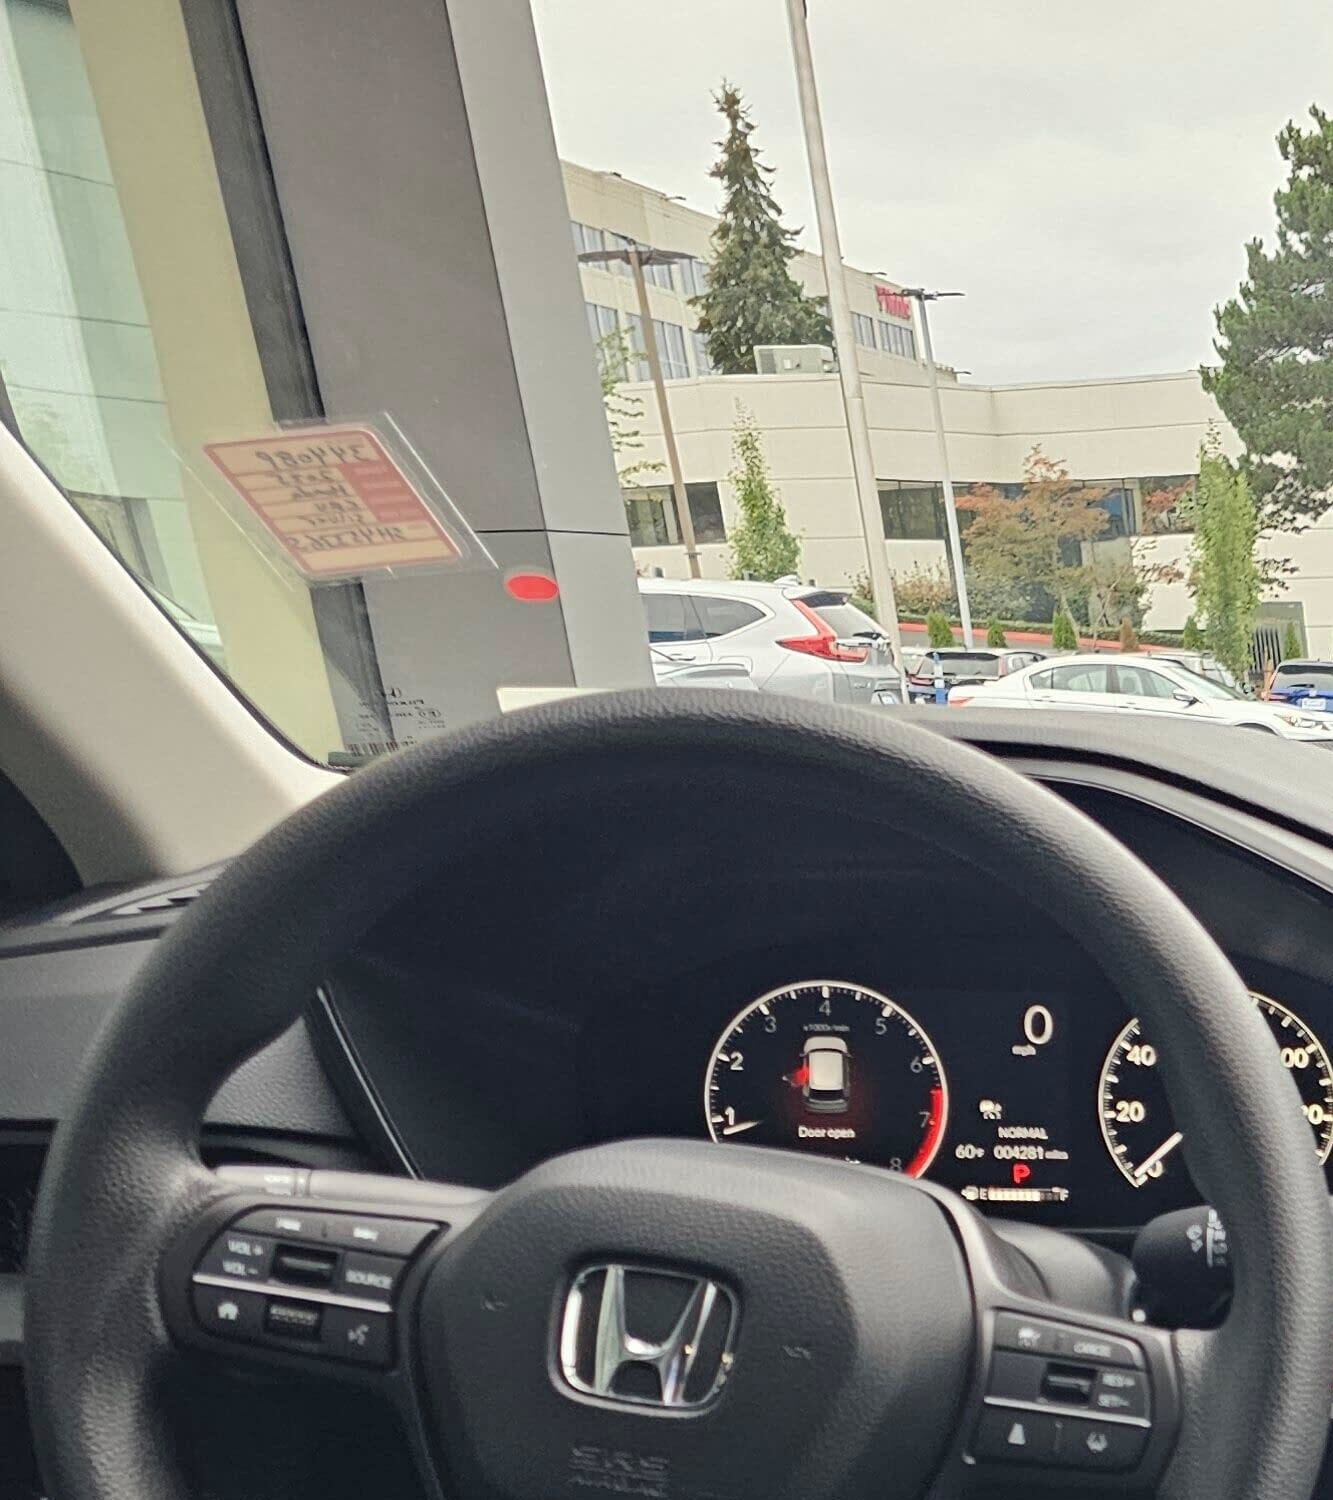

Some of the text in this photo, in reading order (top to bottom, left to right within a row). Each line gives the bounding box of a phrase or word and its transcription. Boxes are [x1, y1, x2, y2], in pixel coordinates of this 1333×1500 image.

[819, 1000, 832, 1017] 4
[765, 1017, 777, 1034] 3
[875, 1018, 888, 1035] 5
[1024, 1004, 1054, 1045] 0
[730, 1051, 744, 1071] 2
[910, 1055, 923, 1073] 6
[1126, 1045, 1157, 1068] 40
[724, 1105, 736, 1126] 1
[919, 1110, 931, 1129] 7
[1115, 1100, 1146, 1123] 20
[798, 1124, 856, 1140] Door open
[998, 1126, 1050, 1140] NORMAL
[889, 1156, 902, 1172] 8
[1012, 1163, 1031, 1184] P
[979, 1187, 989, 1200] E
[345, 1270, 393, 1290] SOURCE
